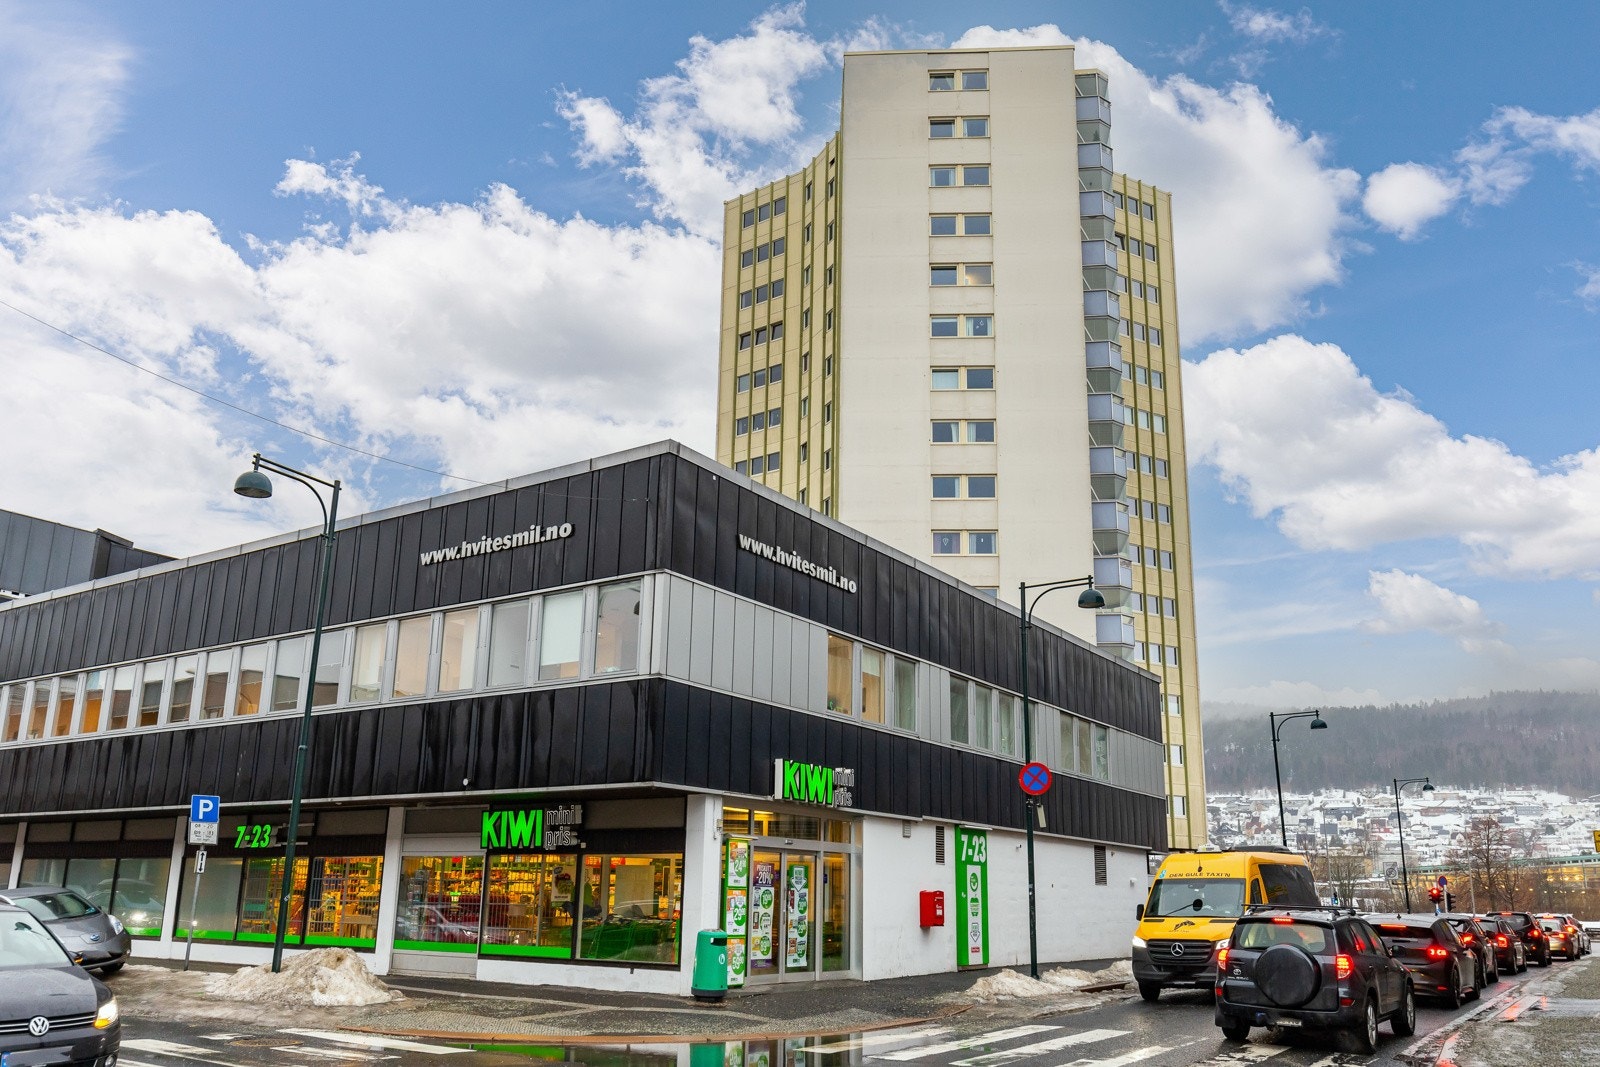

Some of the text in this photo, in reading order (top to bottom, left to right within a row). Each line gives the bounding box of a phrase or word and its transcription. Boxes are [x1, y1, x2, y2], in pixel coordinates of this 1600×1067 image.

[420, 522, 573, 566] www.hvitesmil.no
[738, 533, 858, 594] www.hvitesmil.no
[783, 759, 855, 804] KIWI mini
[198, 799, 214, 820] P
[834, 787, 853, 808] pris
[234, 824, 272, 848] 7-23
[481, 804, 575, 848] KIWI mini
[545, 826, 571, 850] pris
[960, 834, 987, 863] 7-23
